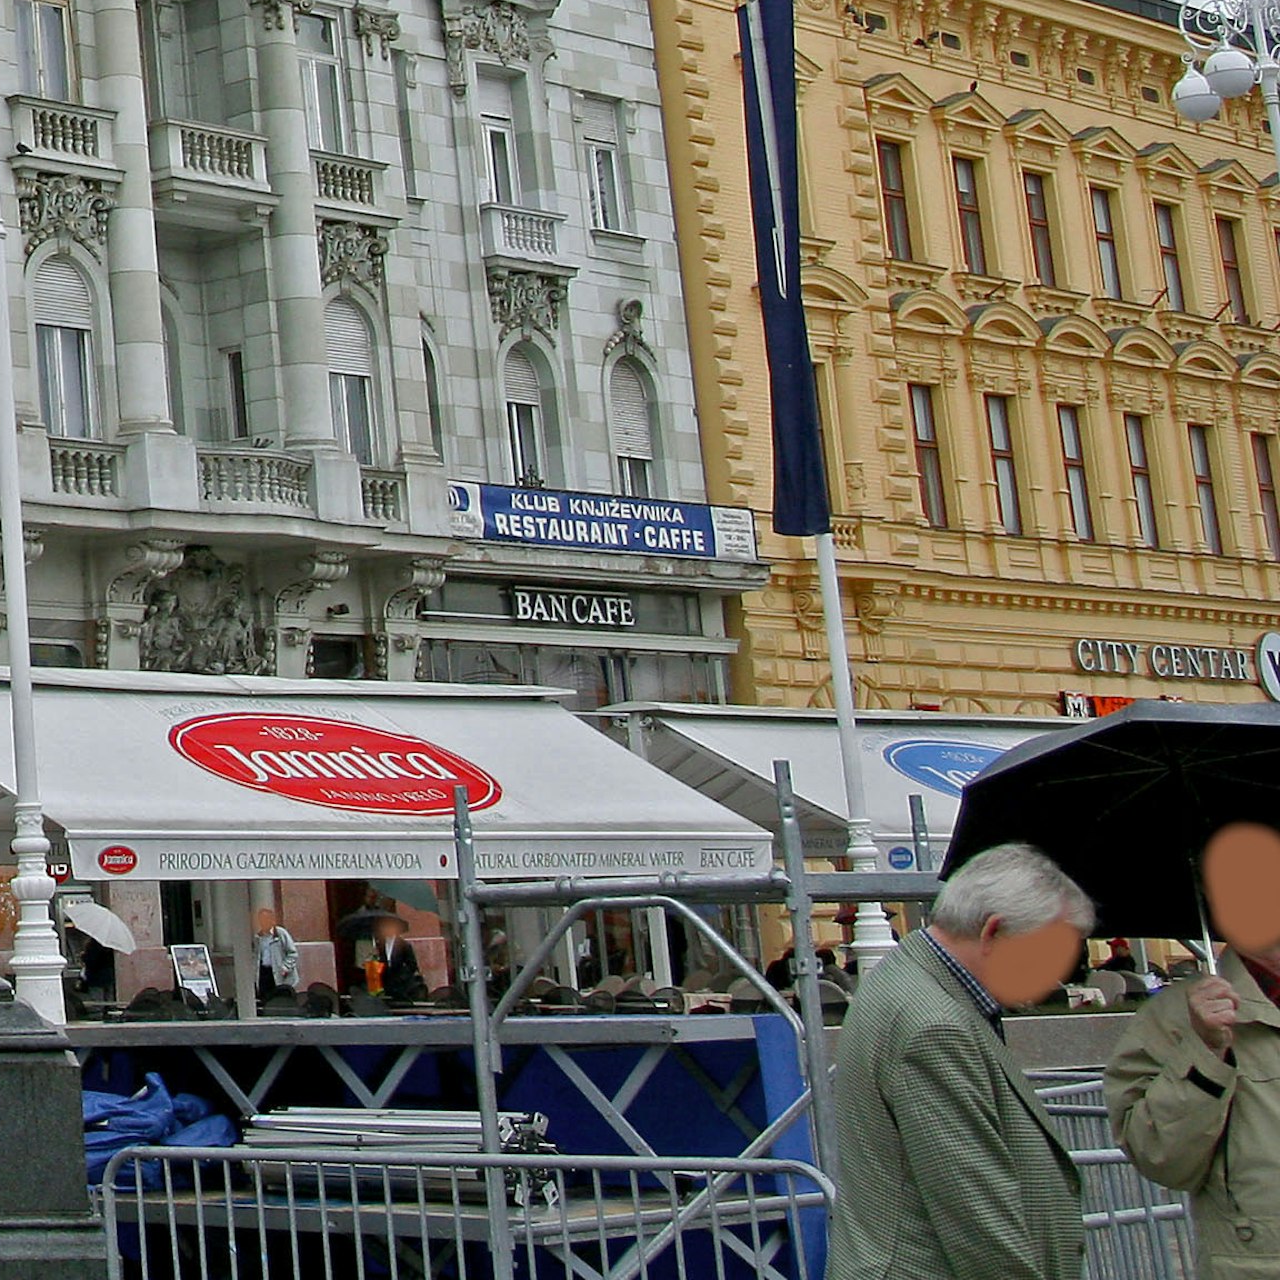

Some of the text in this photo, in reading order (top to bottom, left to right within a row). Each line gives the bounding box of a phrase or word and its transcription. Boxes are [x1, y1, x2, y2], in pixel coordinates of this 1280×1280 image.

[511, 492, 685, 524] KLUB KNJIŽEVNIKA
[494, 513, 629, 545] RESTAURANT
[644, 527, 705, 552] CAFFE
[515, 591, 636, 626] BAN CAFE
[1075, 639, 1140, 674] CITY
[1149, 645, 1251, 680] CENTAR
[214, 745, 459, 782] Jamnica
[159, 852, 422, 870] PRIRODNA GAZIRANA MINERALNA VODA
[473, 850, 684, 869] ATURAL CARBONATED MINERAL WATER
[700, 850, 755, 868] BAN CAFE
